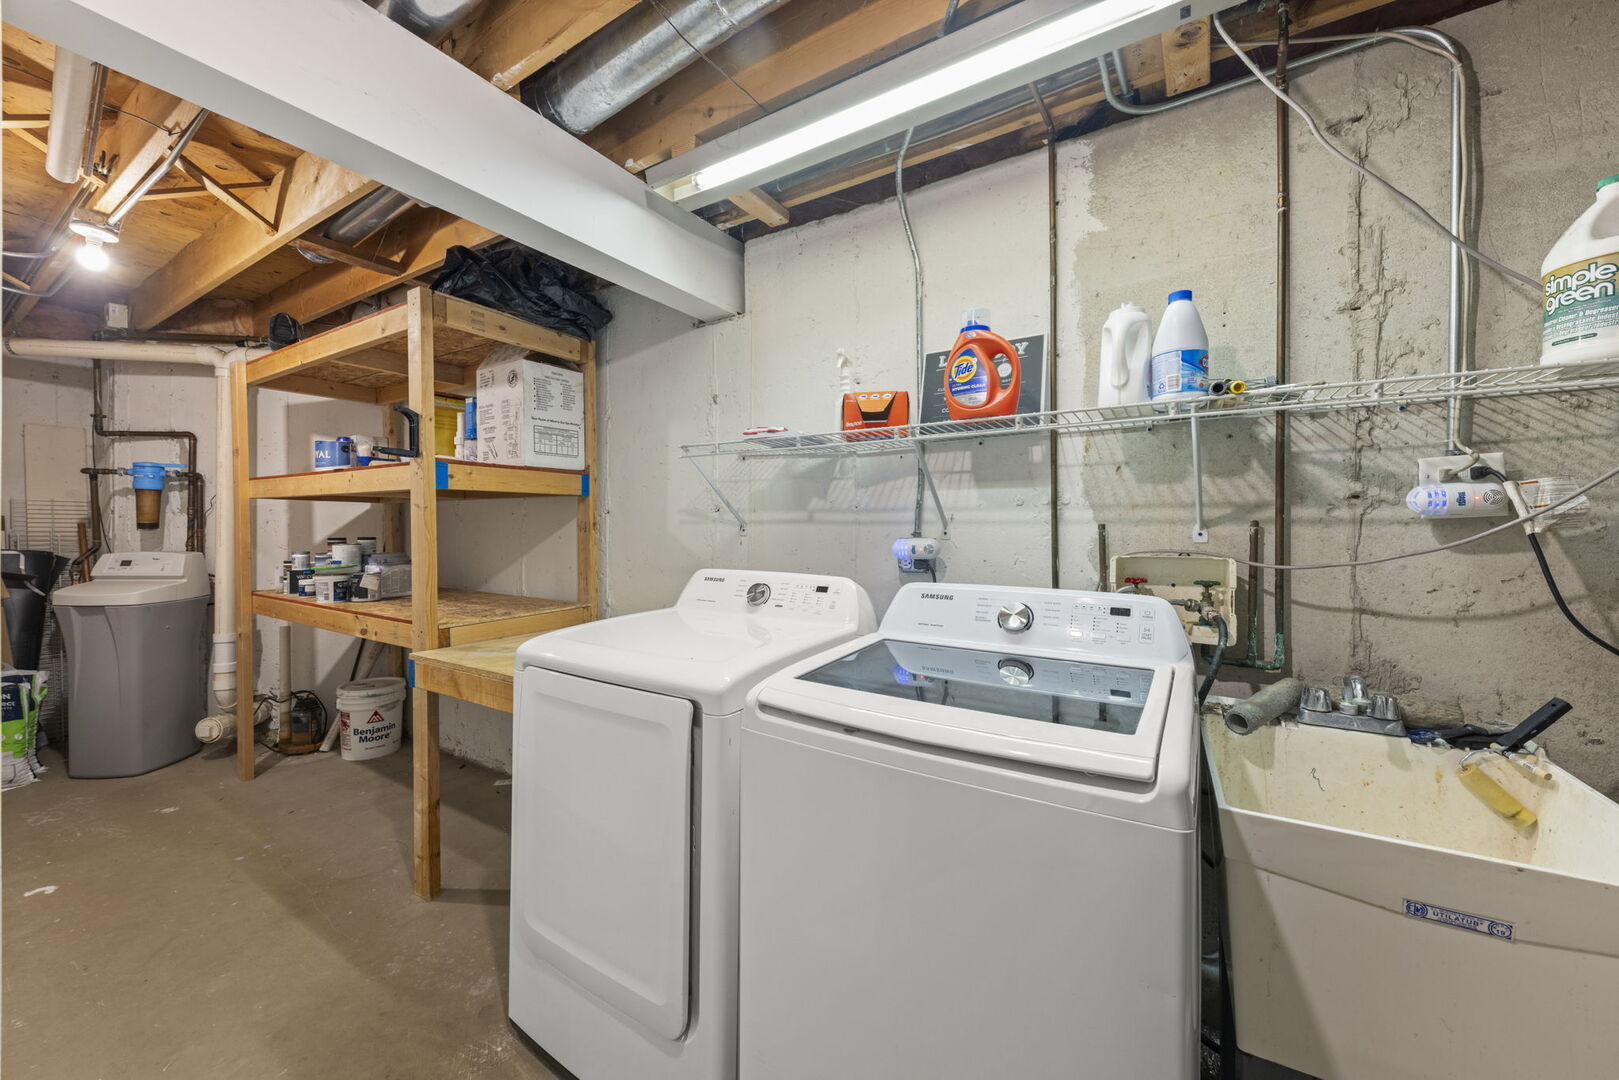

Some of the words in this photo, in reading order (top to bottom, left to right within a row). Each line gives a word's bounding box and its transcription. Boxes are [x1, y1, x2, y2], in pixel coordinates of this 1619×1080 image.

[1546, 262, 1618, 296] simple
[1546, 281, 1614, 315] green
[954, 363, 974, 379] Tide
[920, 593, 954, 601] SAMSUNG
[353, 722, 396, 736] Benjamin
[359, 732, 390, 743] Moore
[1432, 910, 1479, 927] UTILATUB
